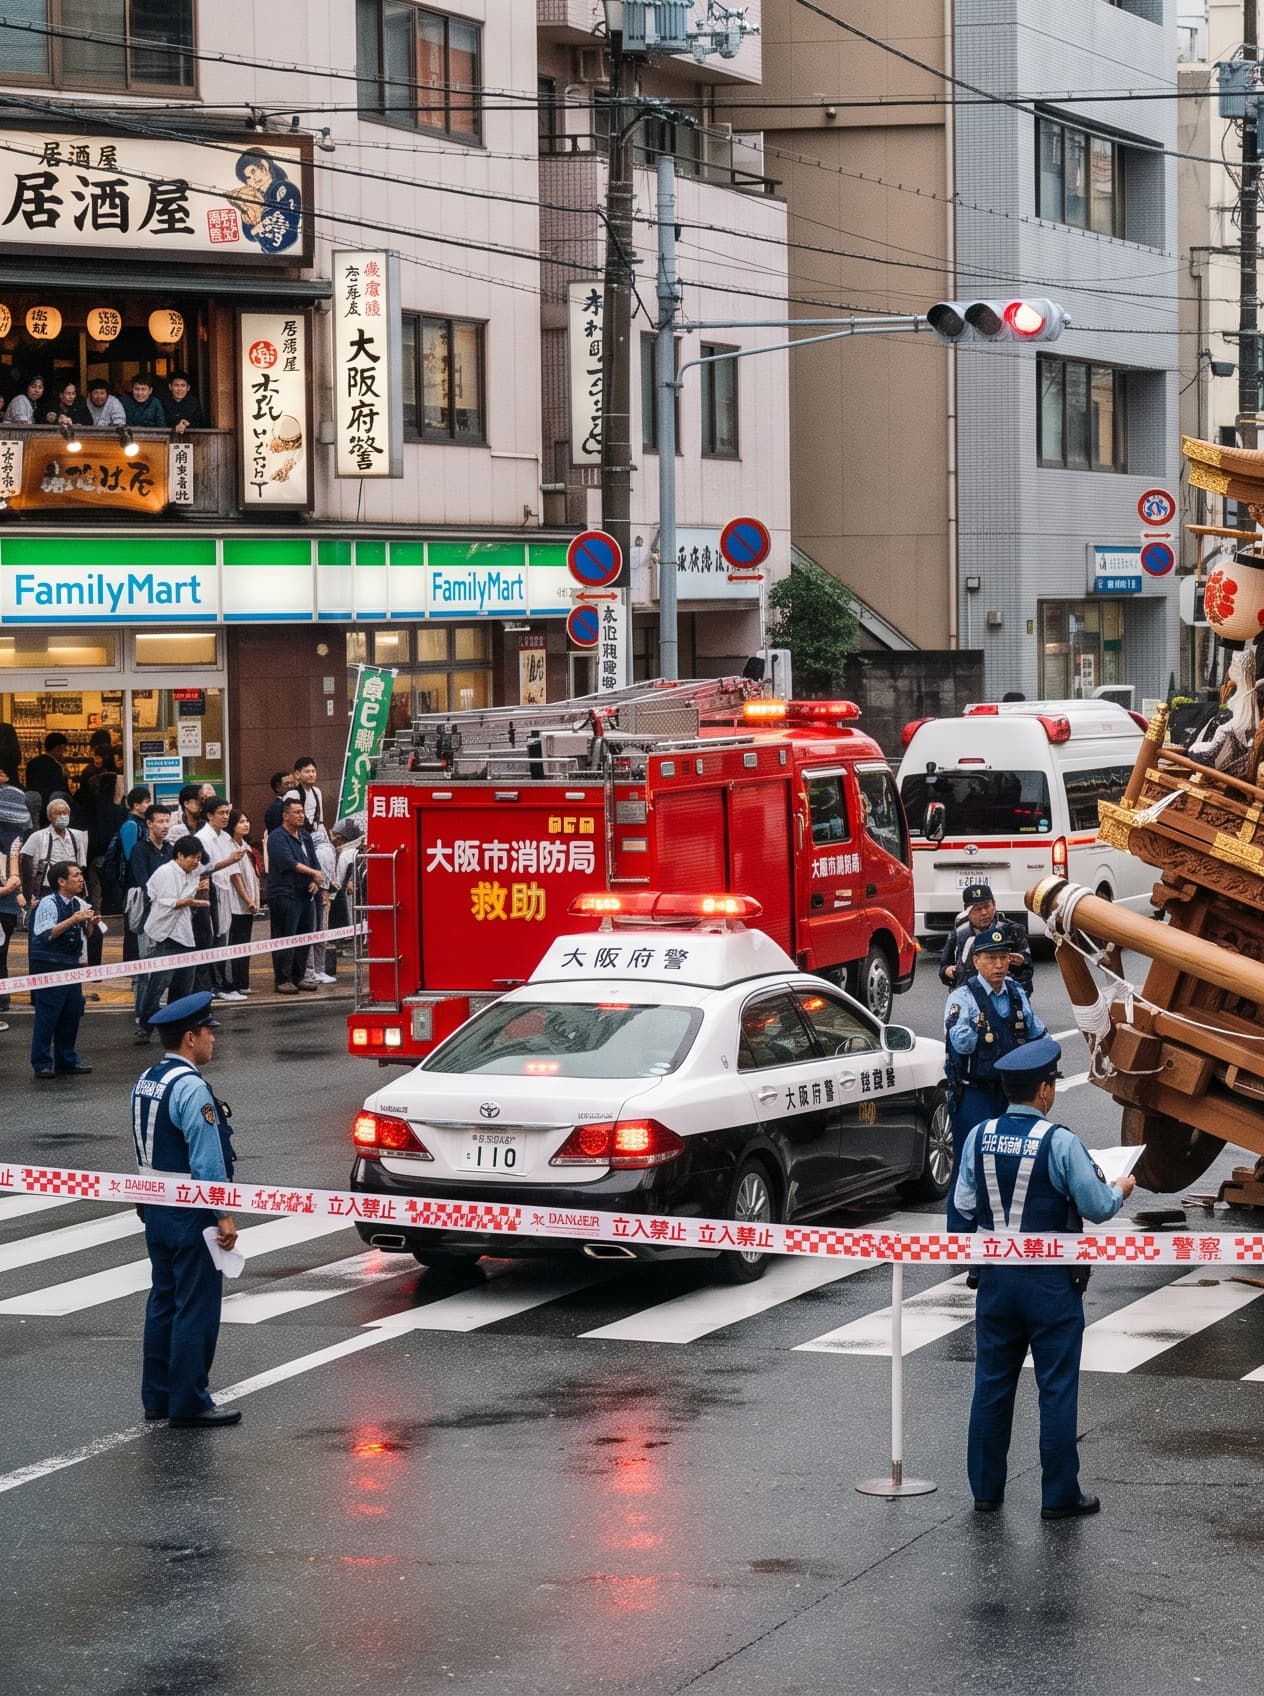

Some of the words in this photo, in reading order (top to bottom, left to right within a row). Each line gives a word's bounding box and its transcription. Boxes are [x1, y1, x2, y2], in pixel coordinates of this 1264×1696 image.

[38, 141, 119, 170] 居酒屋
[2, 171, 196, 236] 居酒屋
[345, 328, 384, 471] 大阪府警
[15, 574, 201, 612] FamilyMart
[432, 571, 524, 609] FamilyMart
[427, 839, 596, 875] 大阪市消防局
[470, 881, 547, 921] 救助
[561, 947, 690, 970] 大阪府警
[786, 1080, 835, 1110] 大阪府警
[477, 1146, 516, 1168] 110
[176, 1184, 241, 1208] 立入禁止
[327, 1196, 397, 1220] 立入禁止
[612, 1217, 687, 1242] 立入禁止
[698, 1224, 774, 1248] 立入禁止
[983, 1237, 1064, 1259] 立入禁止
[1172, 1236, 1222, 1261] 警察
